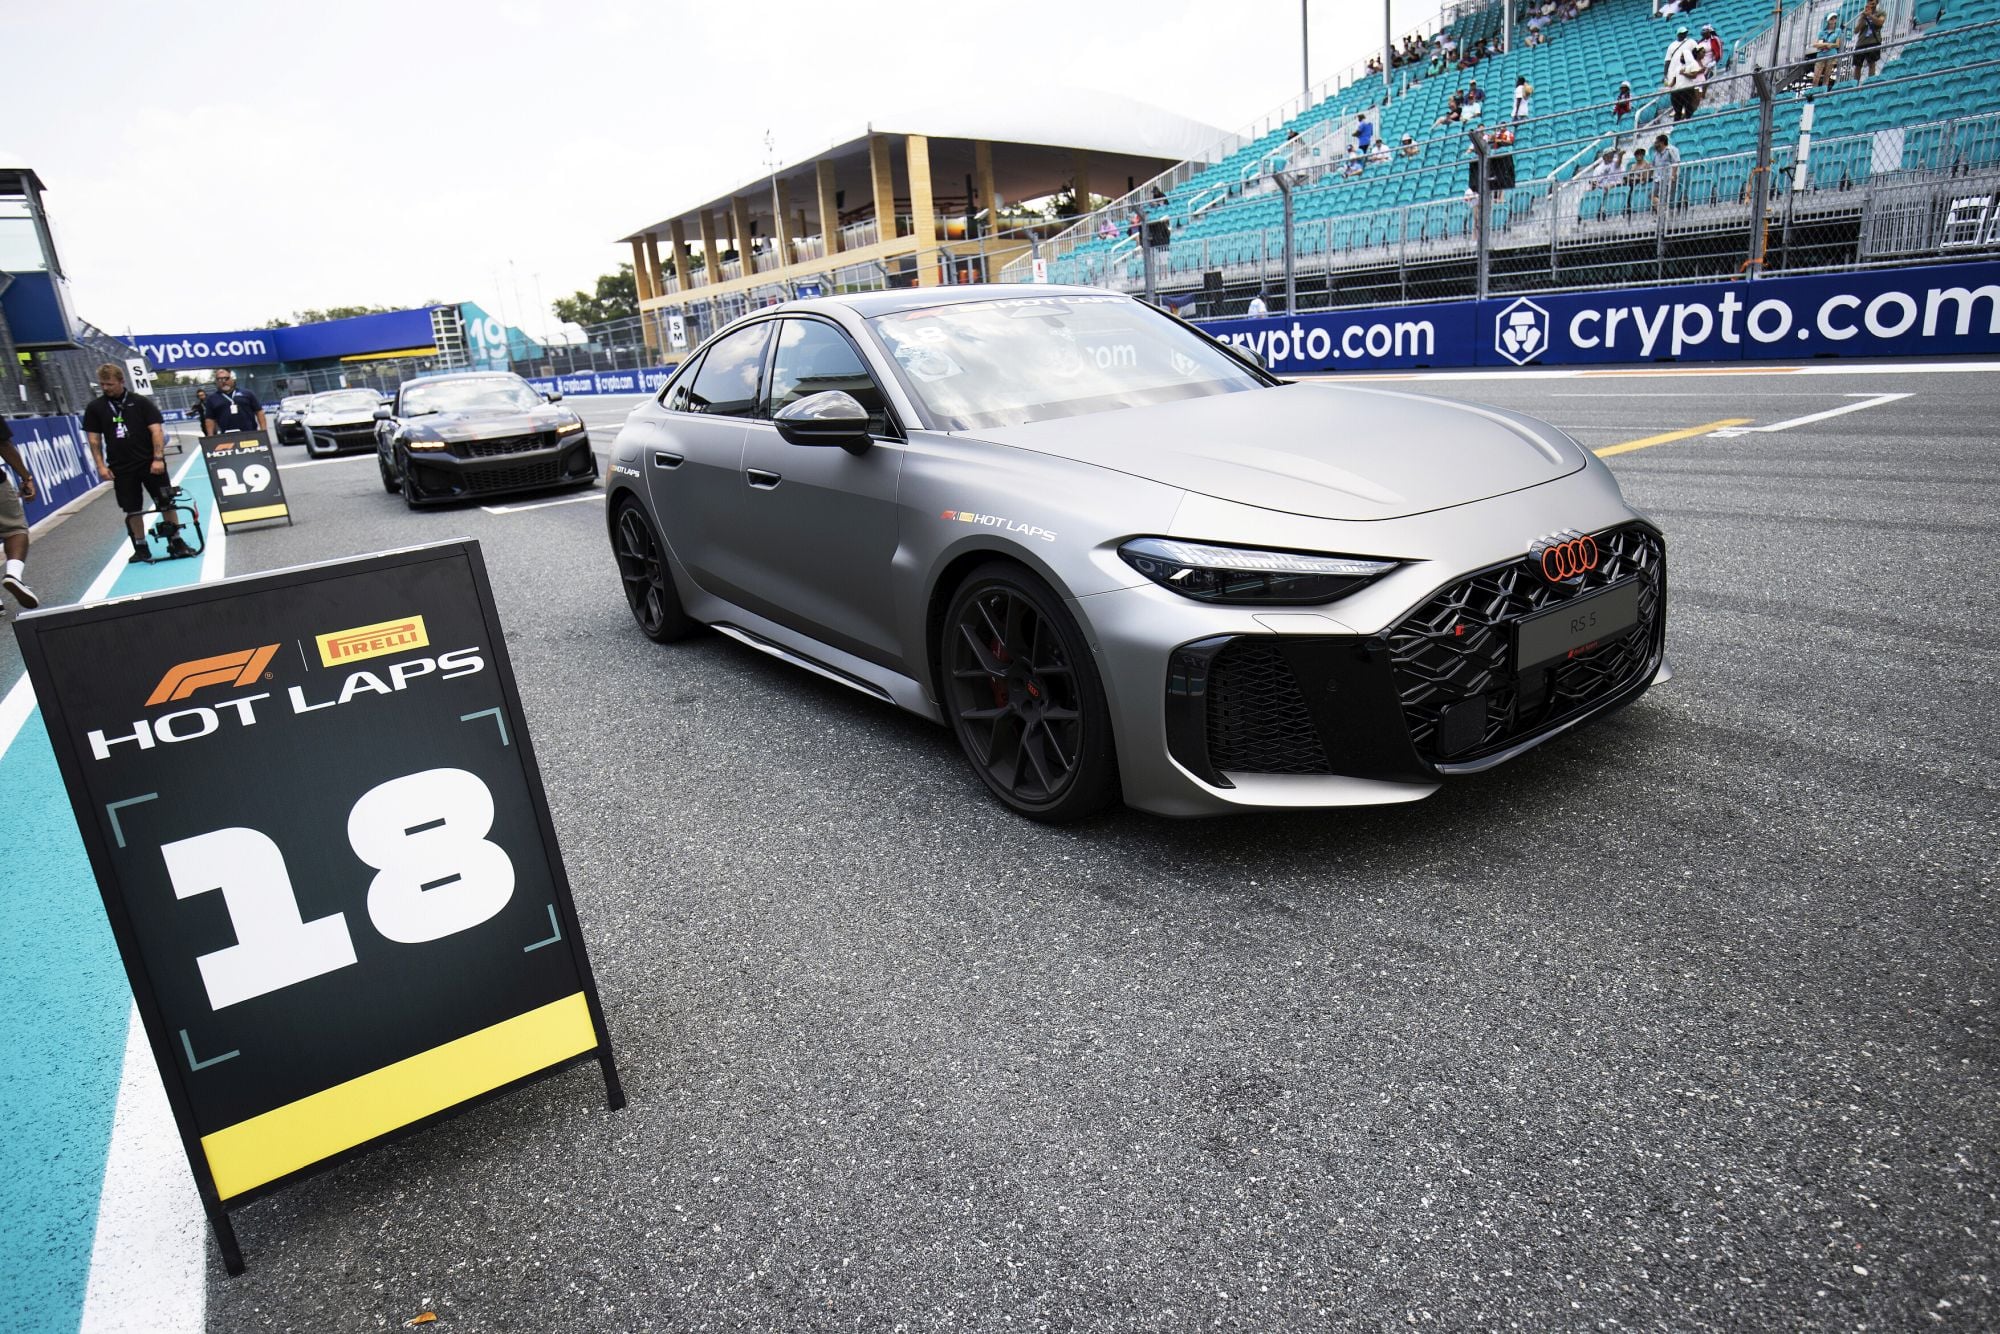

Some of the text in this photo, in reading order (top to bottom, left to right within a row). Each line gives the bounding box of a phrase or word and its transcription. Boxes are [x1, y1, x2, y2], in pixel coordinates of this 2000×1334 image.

[471, 317, 507, 360] 19
[1569, 284, 2000, 357] crypto.com
[217, 463, 272, 497] 19
[974, 513, 1006, 528] HOT
[1006, 520, 1058, 542] LAPS
[326, 623, 419, 660] PIRELLI
[1570, 611, 1598, 635] RS 5
[87, 646, 485, 760] HOT LAPS
[160, 767, 515, 1011] 18
